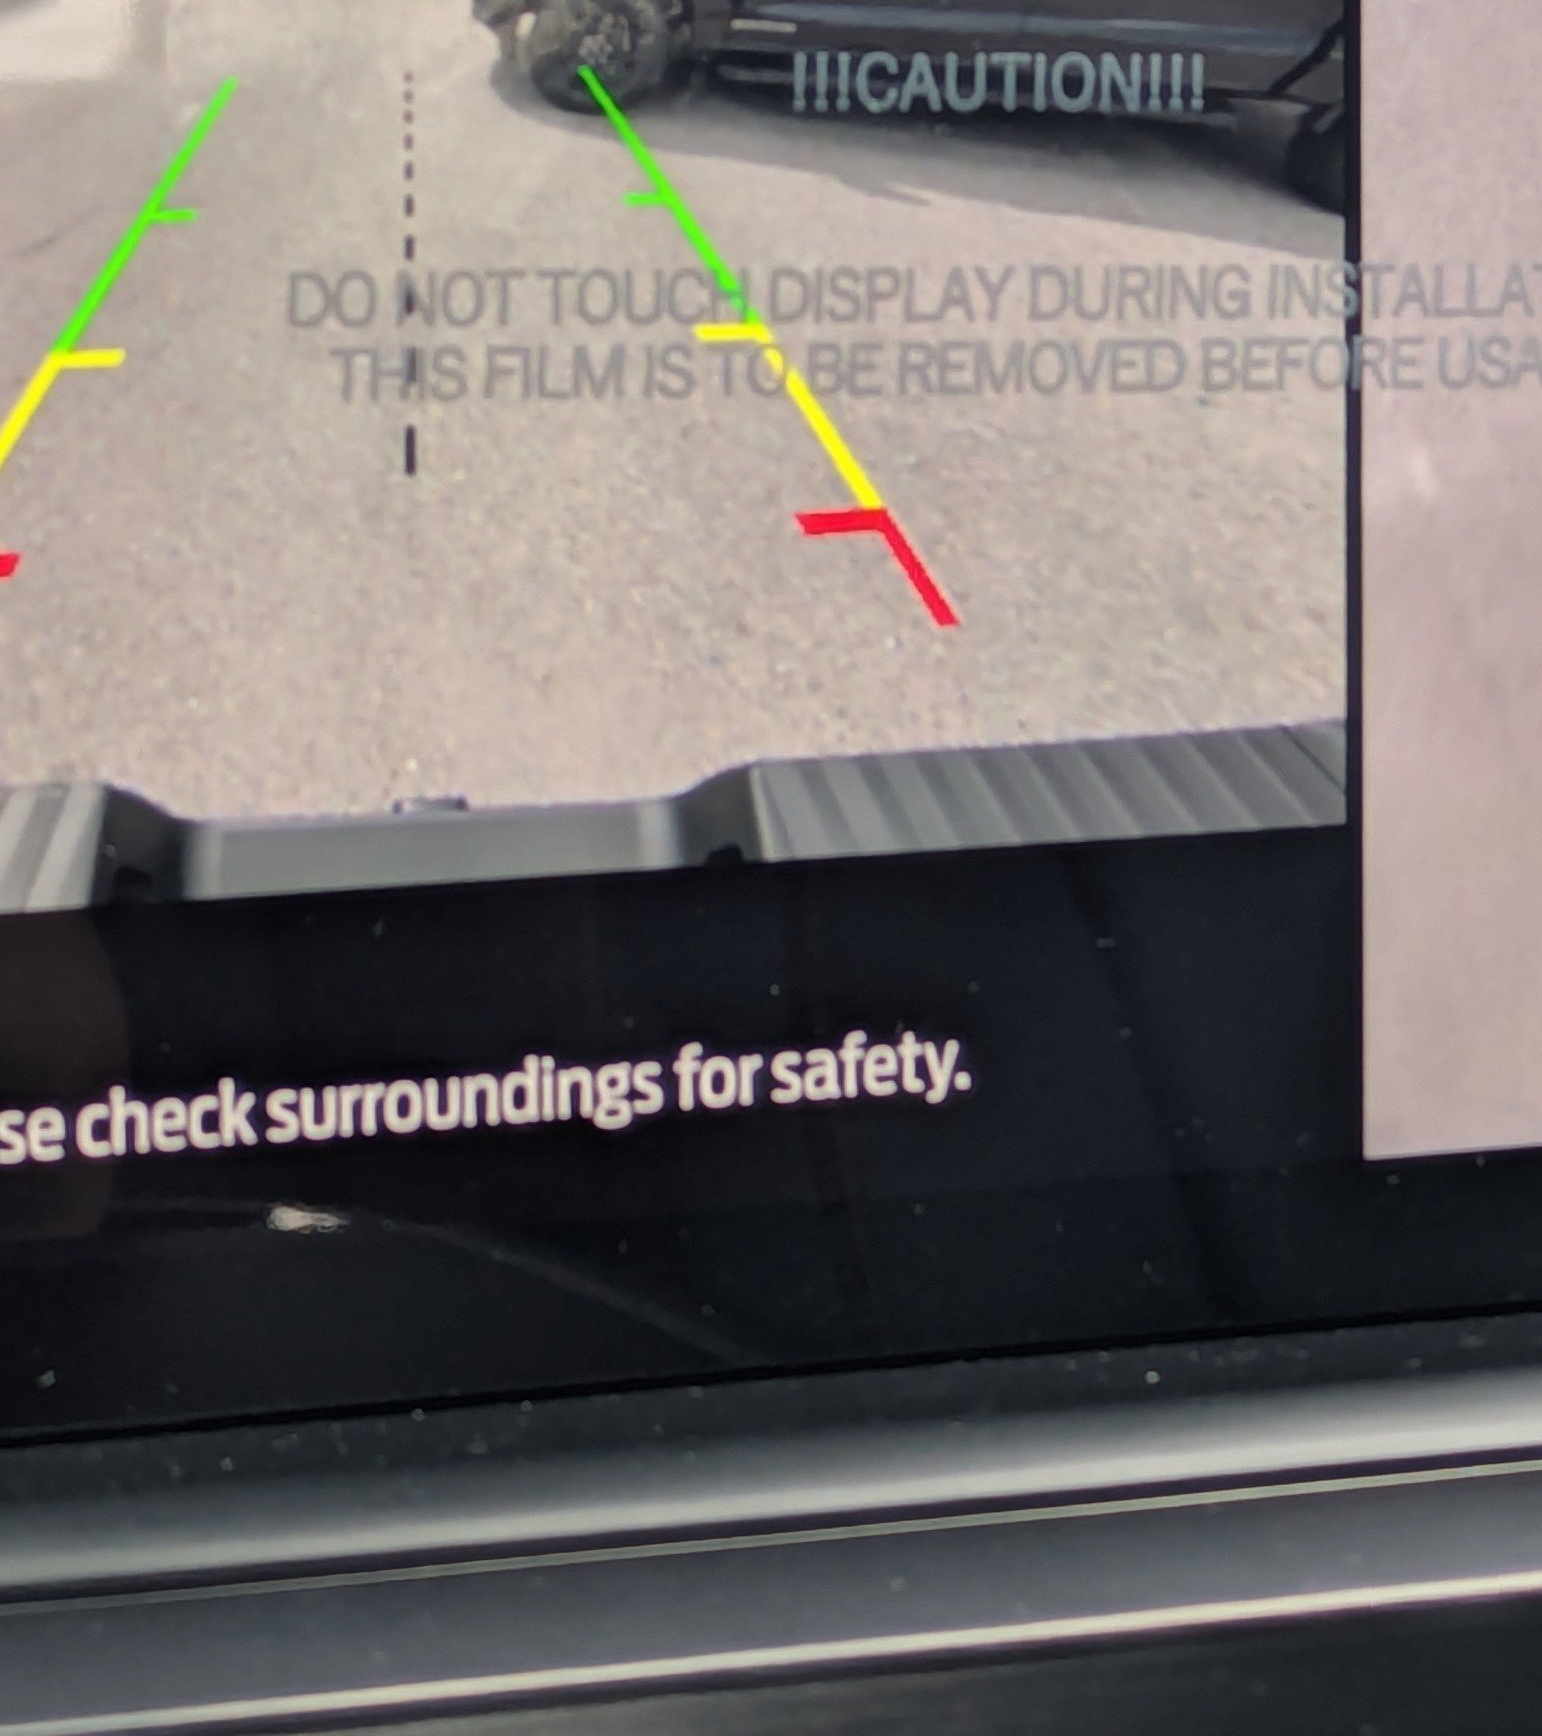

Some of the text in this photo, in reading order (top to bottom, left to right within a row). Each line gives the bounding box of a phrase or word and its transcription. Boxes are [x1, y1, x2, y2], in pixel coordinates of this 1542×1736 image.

[792, 50, 1205, 113] !!!CAUTION!!!
[287, 268, 376, 328] DO
[396, 268, 524, 327] NOT
[536, 267, 750, 326] TOUCH
[769, 265, 1016, 325] DISPLAY
[1027, 264, 1251, 322] DURING
[329, 345, 468, 402] THIS
[484, 344, 625, 401] FILM
[643, 342, 695, 399] IS
[712, 342, 788, 397] TO
[807, 341, 883, 396] BE
[898, 337, 1187, 396] REMOVED
[1200, 334, 1424, 392] BEFORE
[74, 1077, 258, 1160] check
[264, 1055, 665, 1146] surroundings
[671, 1042, 763, 1116] for
[770, 1030, 974, 1106] safety.
